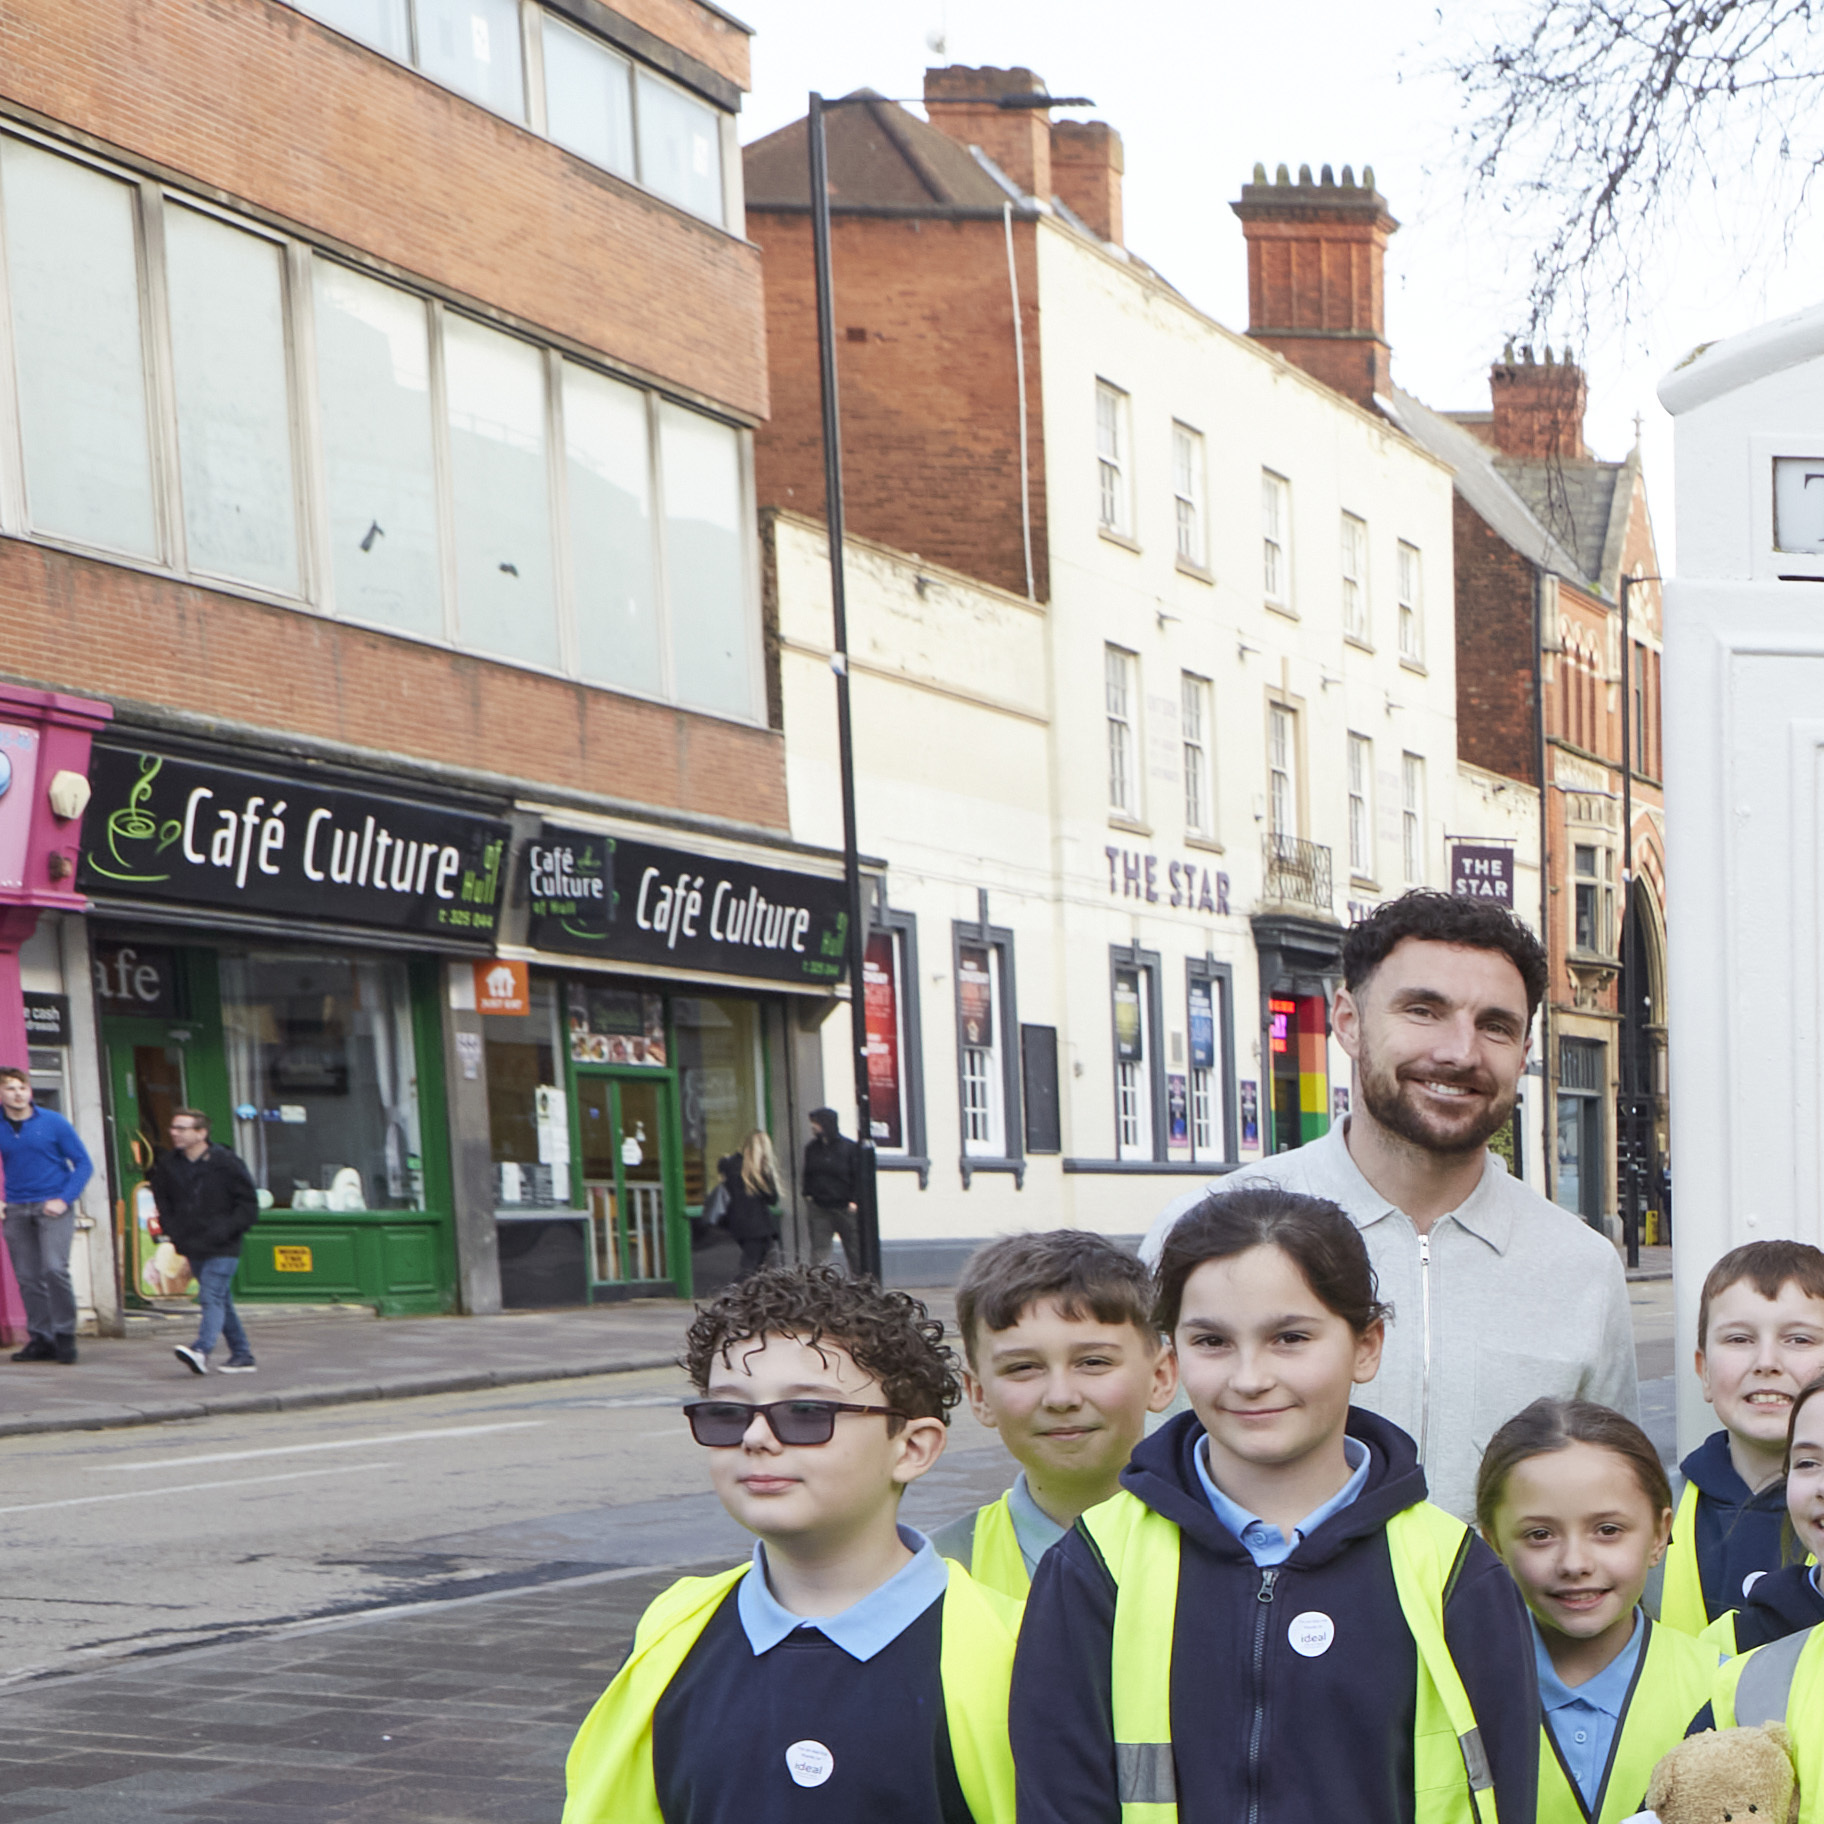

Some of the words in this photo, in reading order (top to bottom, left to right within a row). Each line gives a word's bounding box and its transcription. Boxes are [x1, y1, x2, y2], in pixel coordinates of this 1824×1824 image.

[183, 787, 288, 889] Café
[303, 808, 460, 900] Culture
[530, 845, 575, 874] Café
[1461, 857, 1503, 877] THE
[530, 869, 605, 899] Culture
[1105, 845, 1158, 903] THE
[1169, 860, 1231, 916] STAR
[1455, 878, 1508, 898] STAR
[636, 866, 705, 950] Café
[709, 880, 811, 953] Culture
